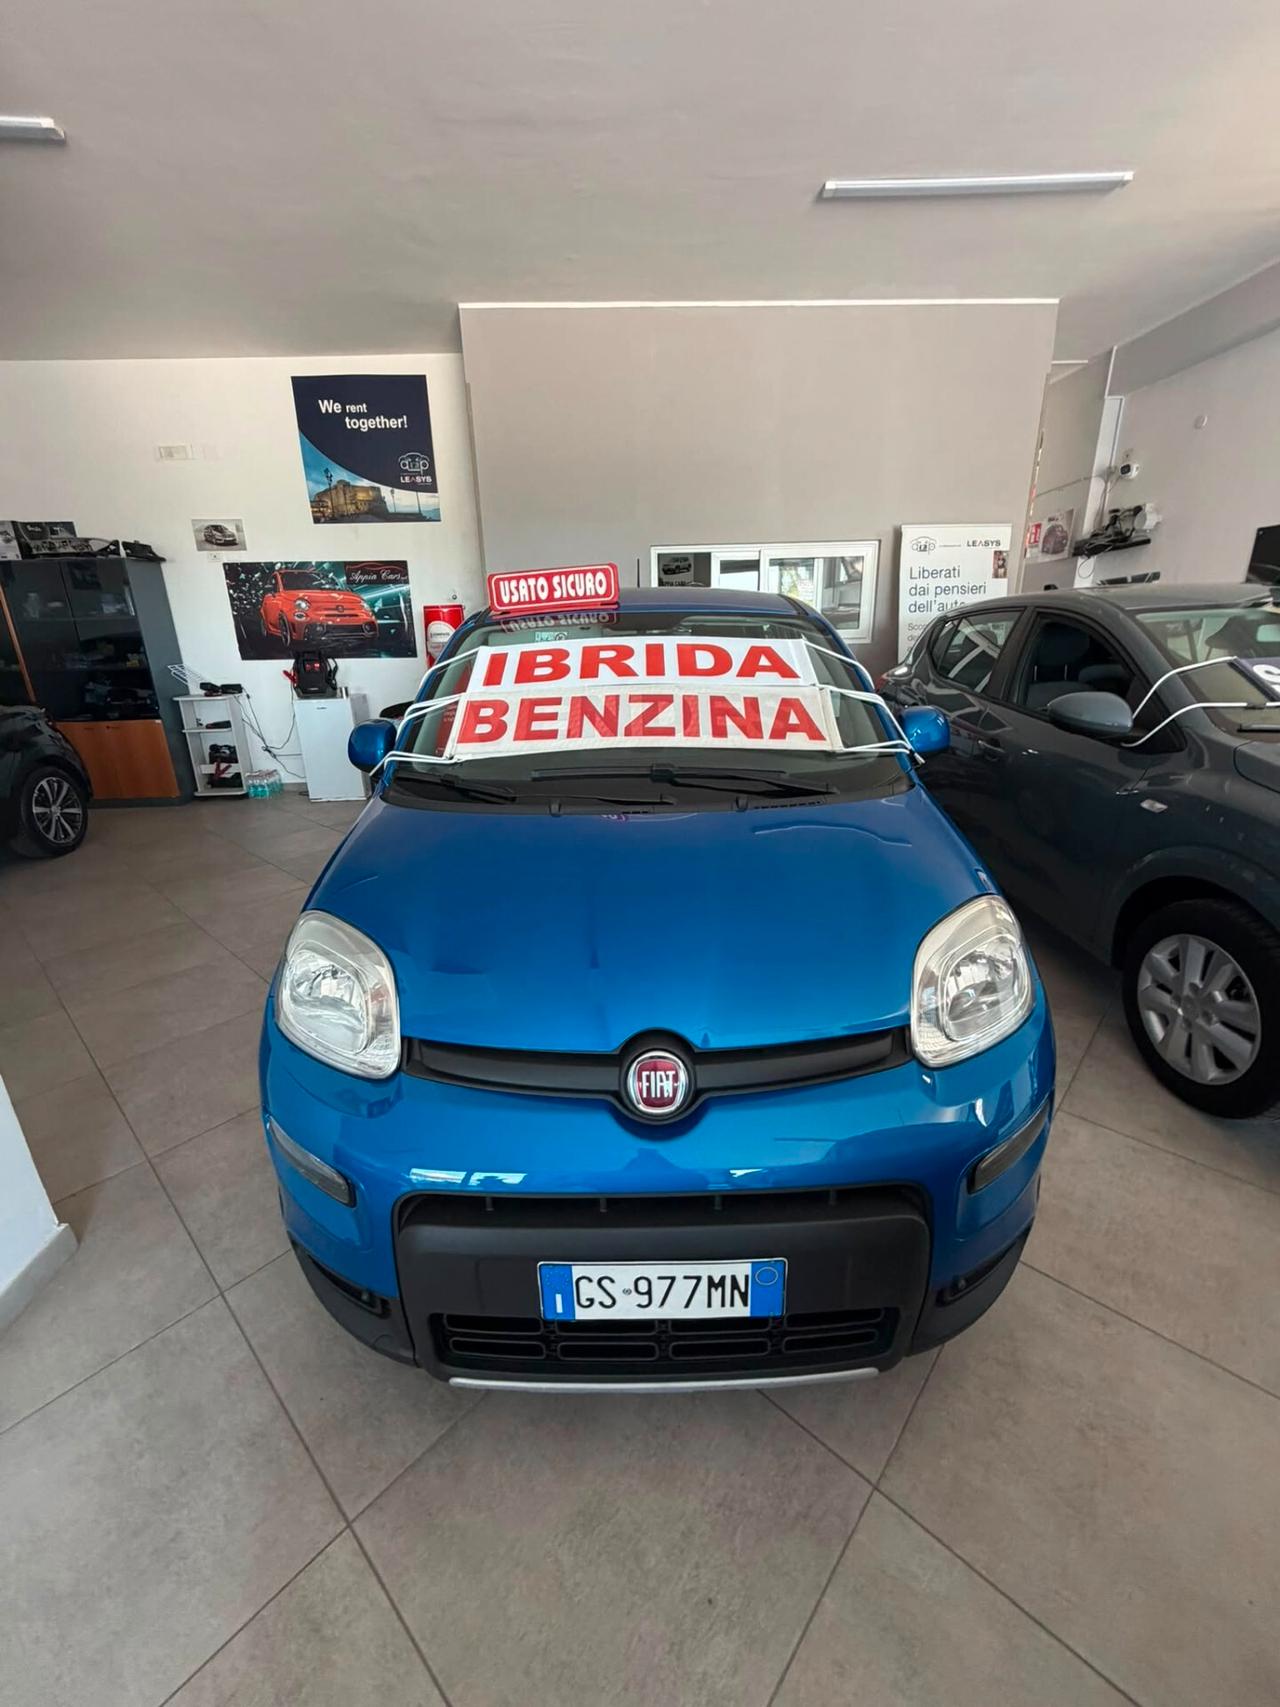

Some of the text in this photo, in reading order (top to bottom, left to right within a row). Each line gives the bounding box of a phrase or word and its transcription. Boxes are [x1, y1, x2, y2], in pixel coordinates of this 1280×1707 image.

[318, 399, 367, 414] We rent
[345, 415, 408, 432] together!
[966, 539, 1001, 548] LEASYS
[909, 566, 961, 580] Liberati
[499, 571, 607, 604] USATO SICURO
[908, 582, 987, 599] dai pensieri
[482, 643, 801, 687] IBRIDA
[456, 694, 827, 744] BENZINA
[641, 1071, 676, 1098] FIAT
